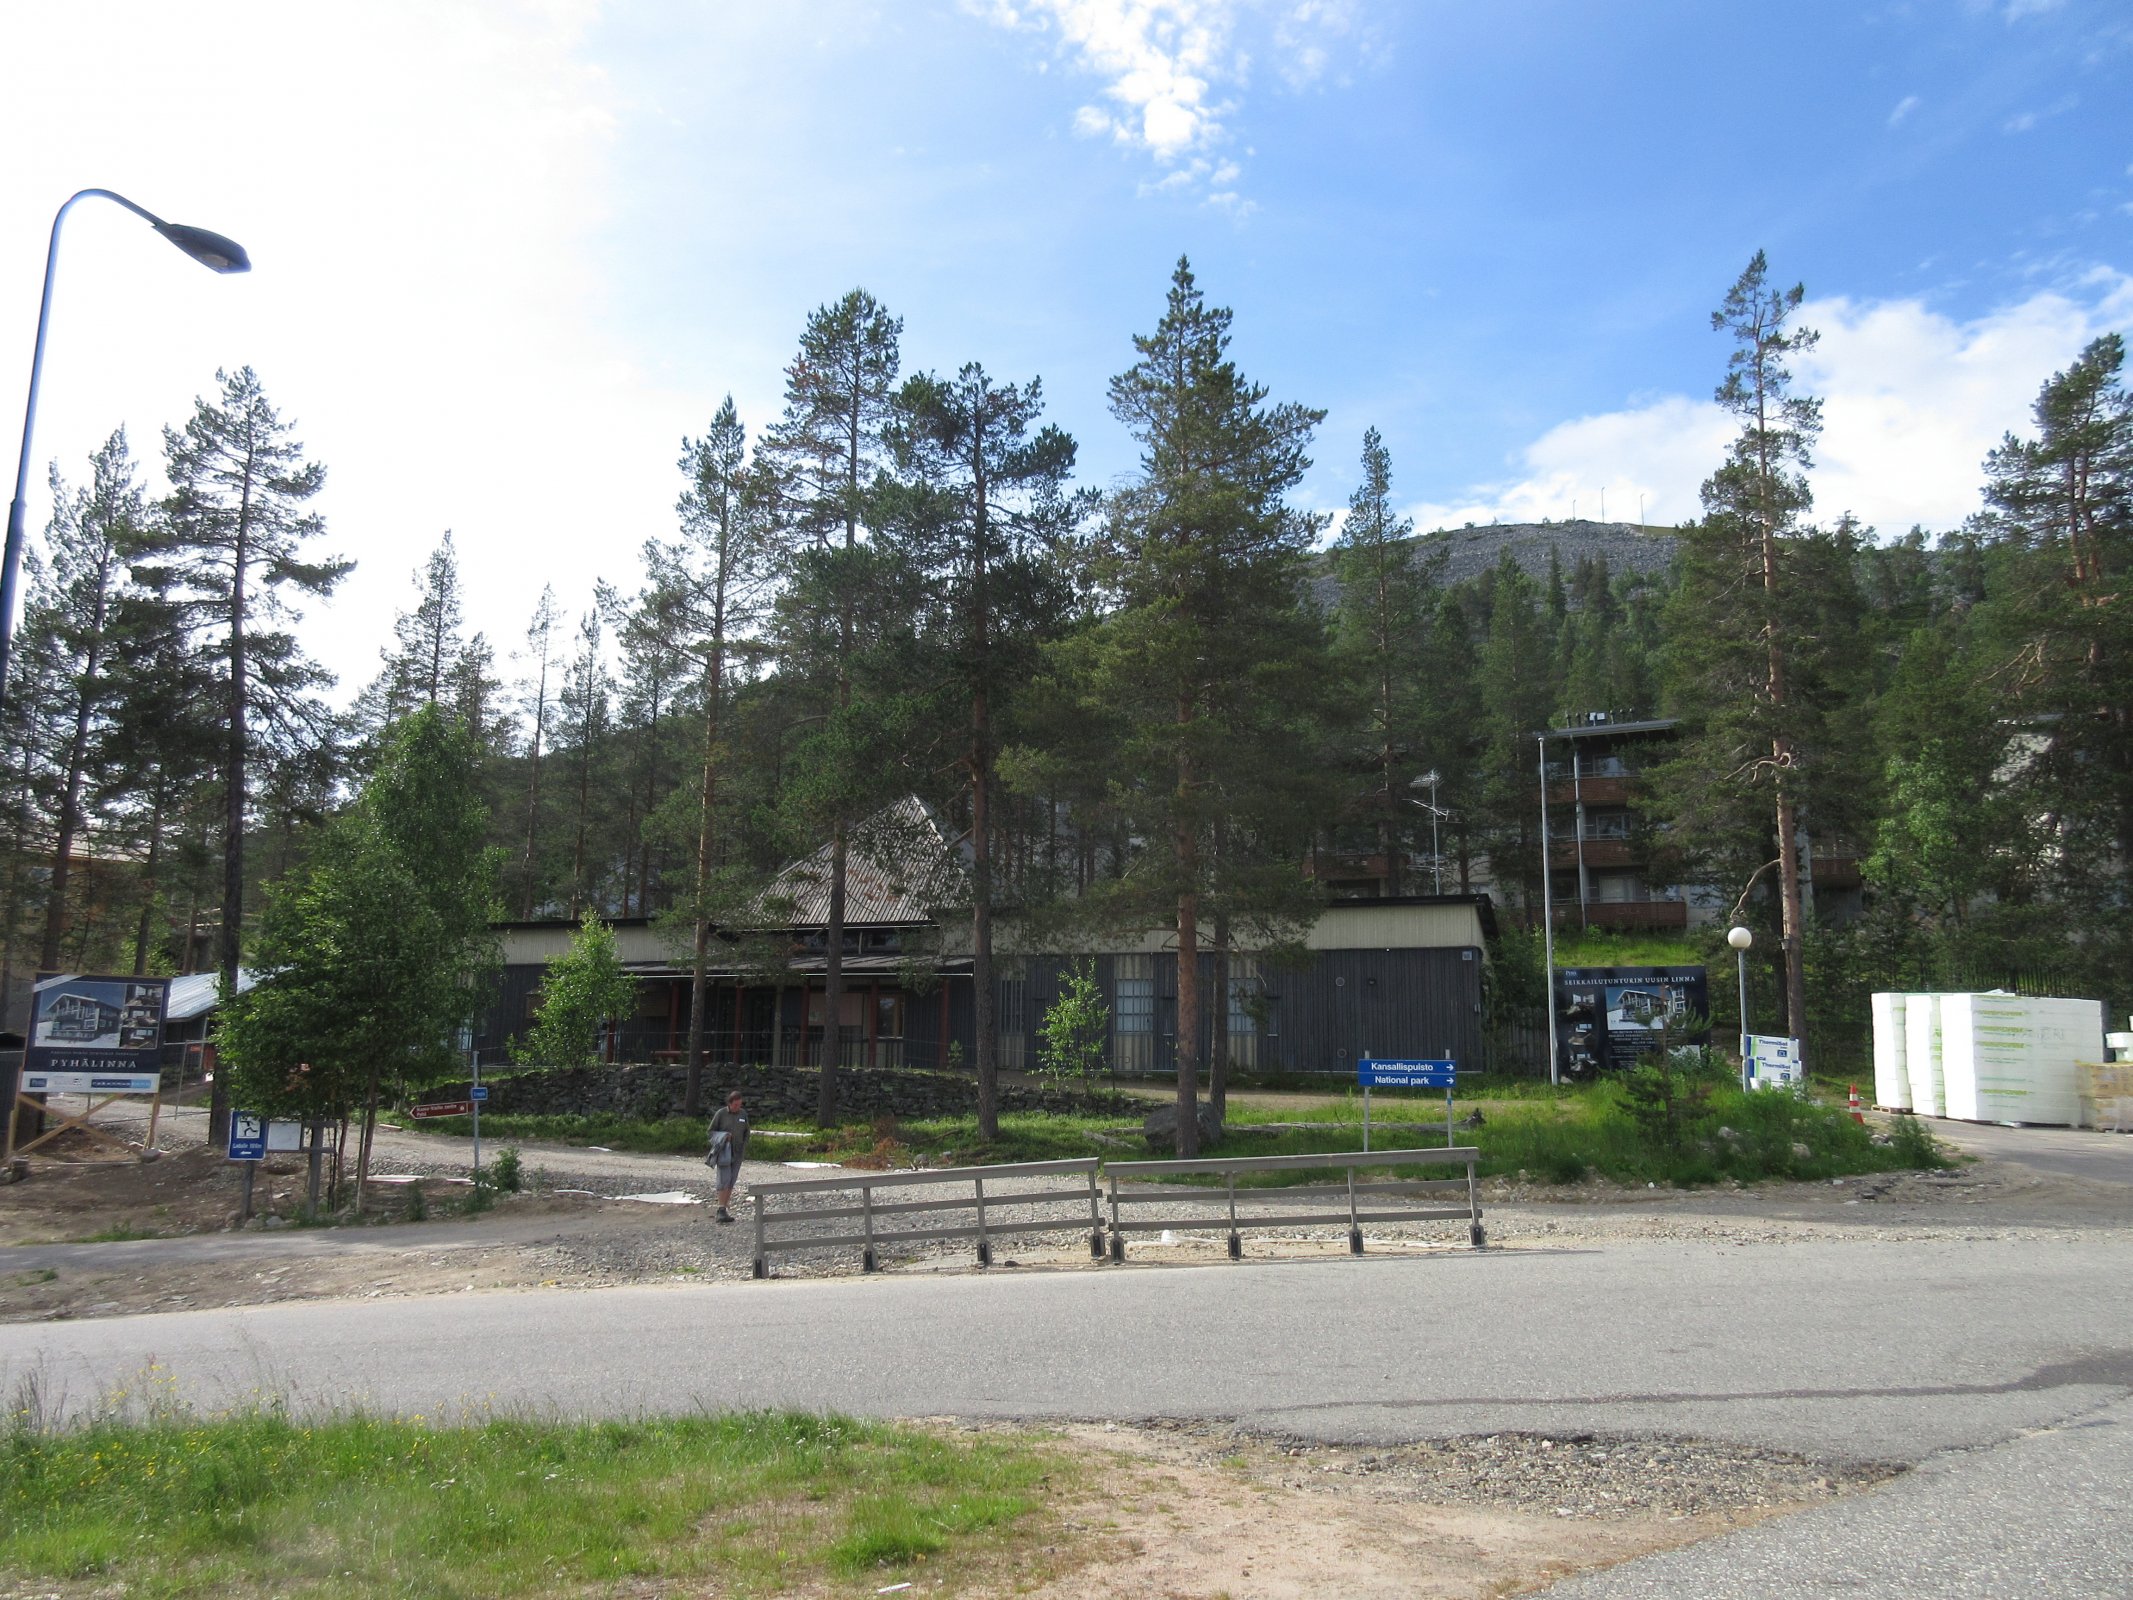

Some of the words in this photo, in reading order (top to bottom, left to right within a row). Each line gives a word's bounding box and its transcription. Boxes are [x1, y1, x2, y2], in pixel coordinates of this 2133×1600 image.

[1564, 977, 1643, 986] SEIKKAILUTUNTURIN
[50, 1058, 137, 1068] PYHÄLINNA
[1371, 1062, 1434, 1072] Kansallispuisto
[1375, 1076, 1408, 1085] National
[1410, 1076, 1430, 1086] park
